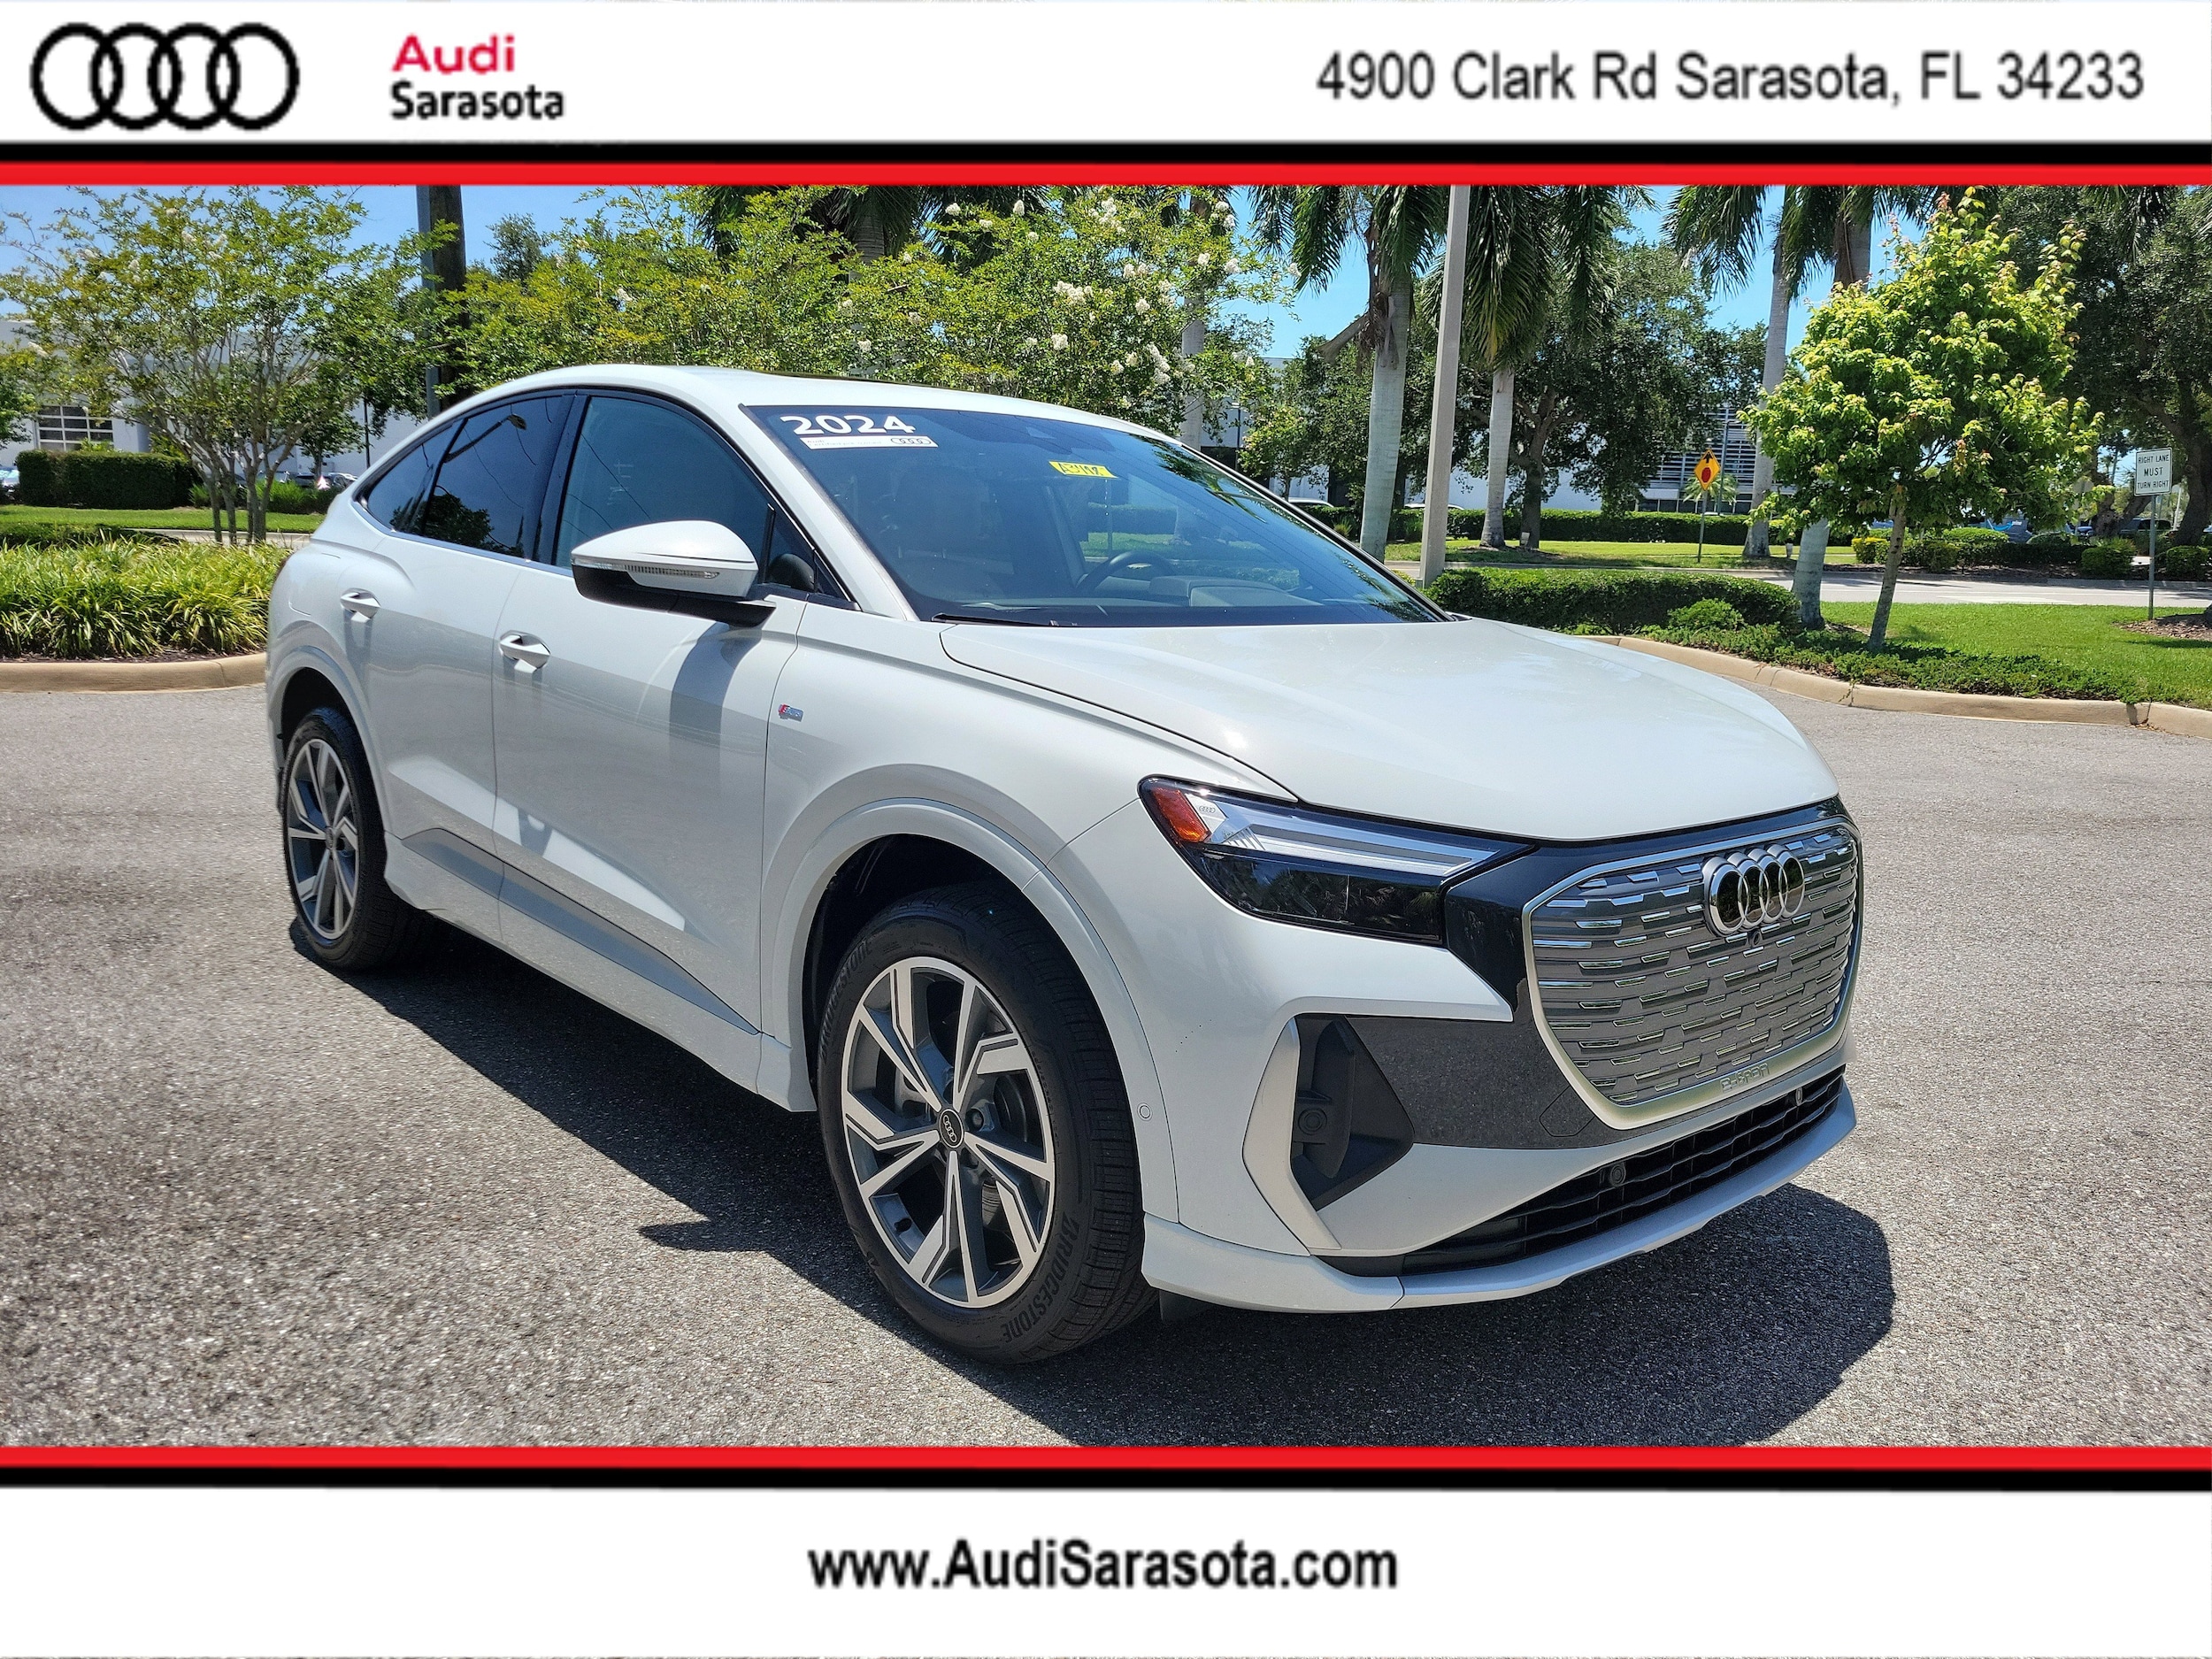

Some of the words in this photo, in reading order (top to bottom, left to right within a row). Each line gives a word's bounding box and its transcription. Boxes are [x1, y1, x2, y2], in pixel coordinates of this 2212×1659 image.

[780, 415, 916, 435] 2024
[2144, 466, 2163, 476] MUST
[2153, 480, 2169, 488] RIGHT
[1001, 1211, 1080, 1344] BRIDGESTONE
